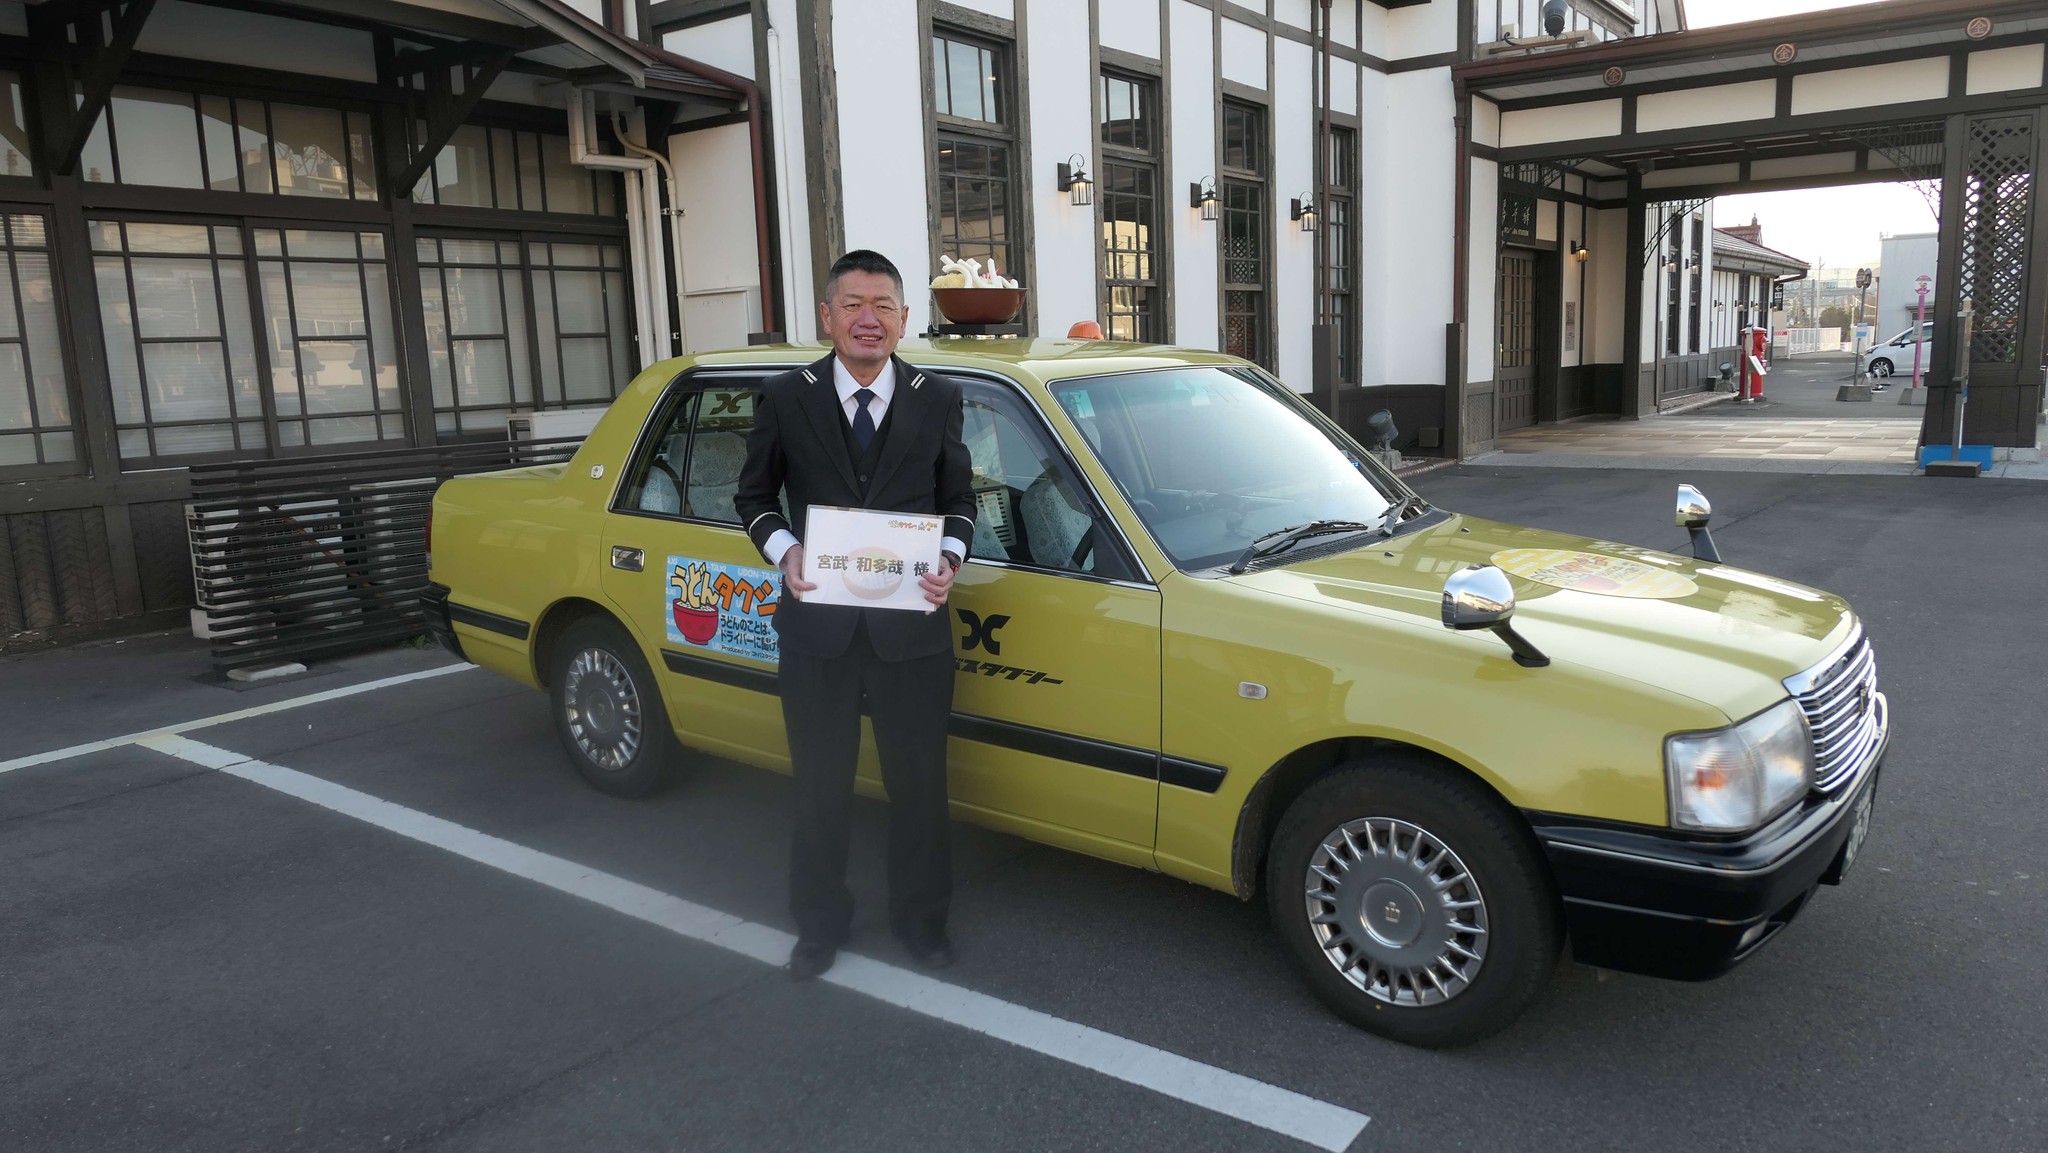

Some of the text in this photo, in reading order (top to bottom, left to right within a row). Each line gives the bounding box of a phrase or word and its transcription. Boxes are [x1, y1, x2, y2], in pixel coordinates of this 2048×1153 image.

[817, 554, 930, 577] 宮武 和多哉 様
[671, 562, 782, 618] うどんタクシ
